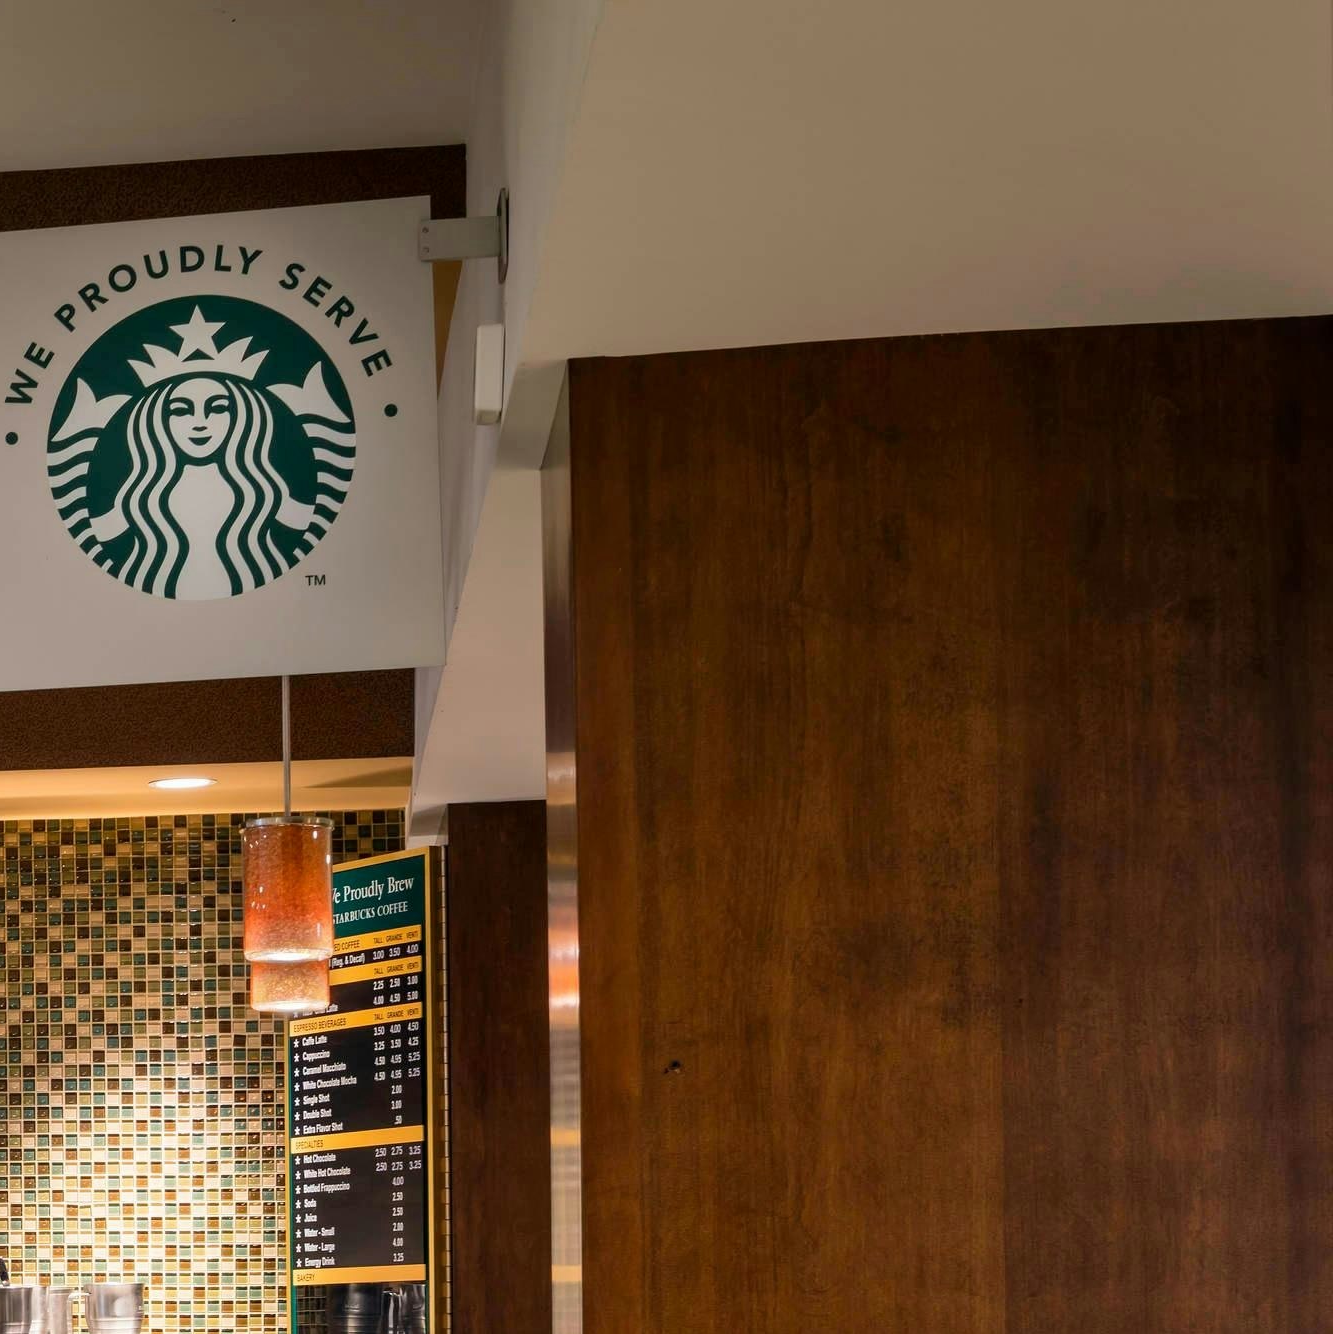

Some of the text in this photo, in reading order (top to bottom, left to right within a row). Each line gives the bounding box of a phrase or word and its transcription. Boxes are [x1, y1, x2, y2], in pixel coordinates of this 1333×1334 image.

[4, 244, 393, 405] WE PROUDLY SERVE
[305, 575, 326, 586] TM
[343, 879, 385, 903] Proudly
[387, 876, 415, 894] Brew
[377, 900, 408, 917] COFFEE
[342, 939, 360, 950] COFFEE
[373, 949, 385, 960] 3.00
[389, 947, 401, 957] 3.50
[406, 944, 419, 953] 4.00
[293, 1021, 317, 1033] ESPRESSO
[318, 1017, 347, 1029] BEVERAGES
[374, 1026, 384, 1036] 3.50
[390, 1024, 401, 1034] 4.00
[407, 1021, 419, 1031] 4.50
[302, 1050, 330, 1062] Cappuccino
[303, 1065, 321, 1076] Caramel
[374, 1056, 385, 1066] 4.50
[408, 1051, 421, 1062] 5.25
[303, 1080, 316, 1090] White
[317, 1077, 340, 1088] Chocolate
[341, 1075, 357, 1085] Mocha
[408, 1067, 421, 1077] 5.25
[303, 1095, 318, 1106] Single
[319, 1093, 330, 1103] Shot
[303, 1109, 319, 1120] Double
[321, 1108, 332, 1118] Shot
[303, 1125, 315, 1135] Extra
[316, 1123, 331, 1133] Flavor
[332, 1122, 343, 1131] Shot
[303, 1145, 421, 1164] Hot Chocolate 2.50 2.75 3.25
[304, 1160, 422, 1179] White Hot Chocolate 2.50 2.75 3.25
[303, 1184, 320, 1194] Bottled
[321, 1181, 350, 1194] Frappuccino
[304, 1199, 317, 1208] Soda
[304, 1213, 317, 1222] Juice
[304, 1228, 318, 1237] Water
[321, 1226, 335, 1236] Small
[304, 1243, 318, 1252] Water
[321, 1243, 335, 1253] Large
[304, 1258, 321, 1268] Energy
[322, 1256, 335, 1266] Drink
[296, 1273, 315, 1282] BAKERY
